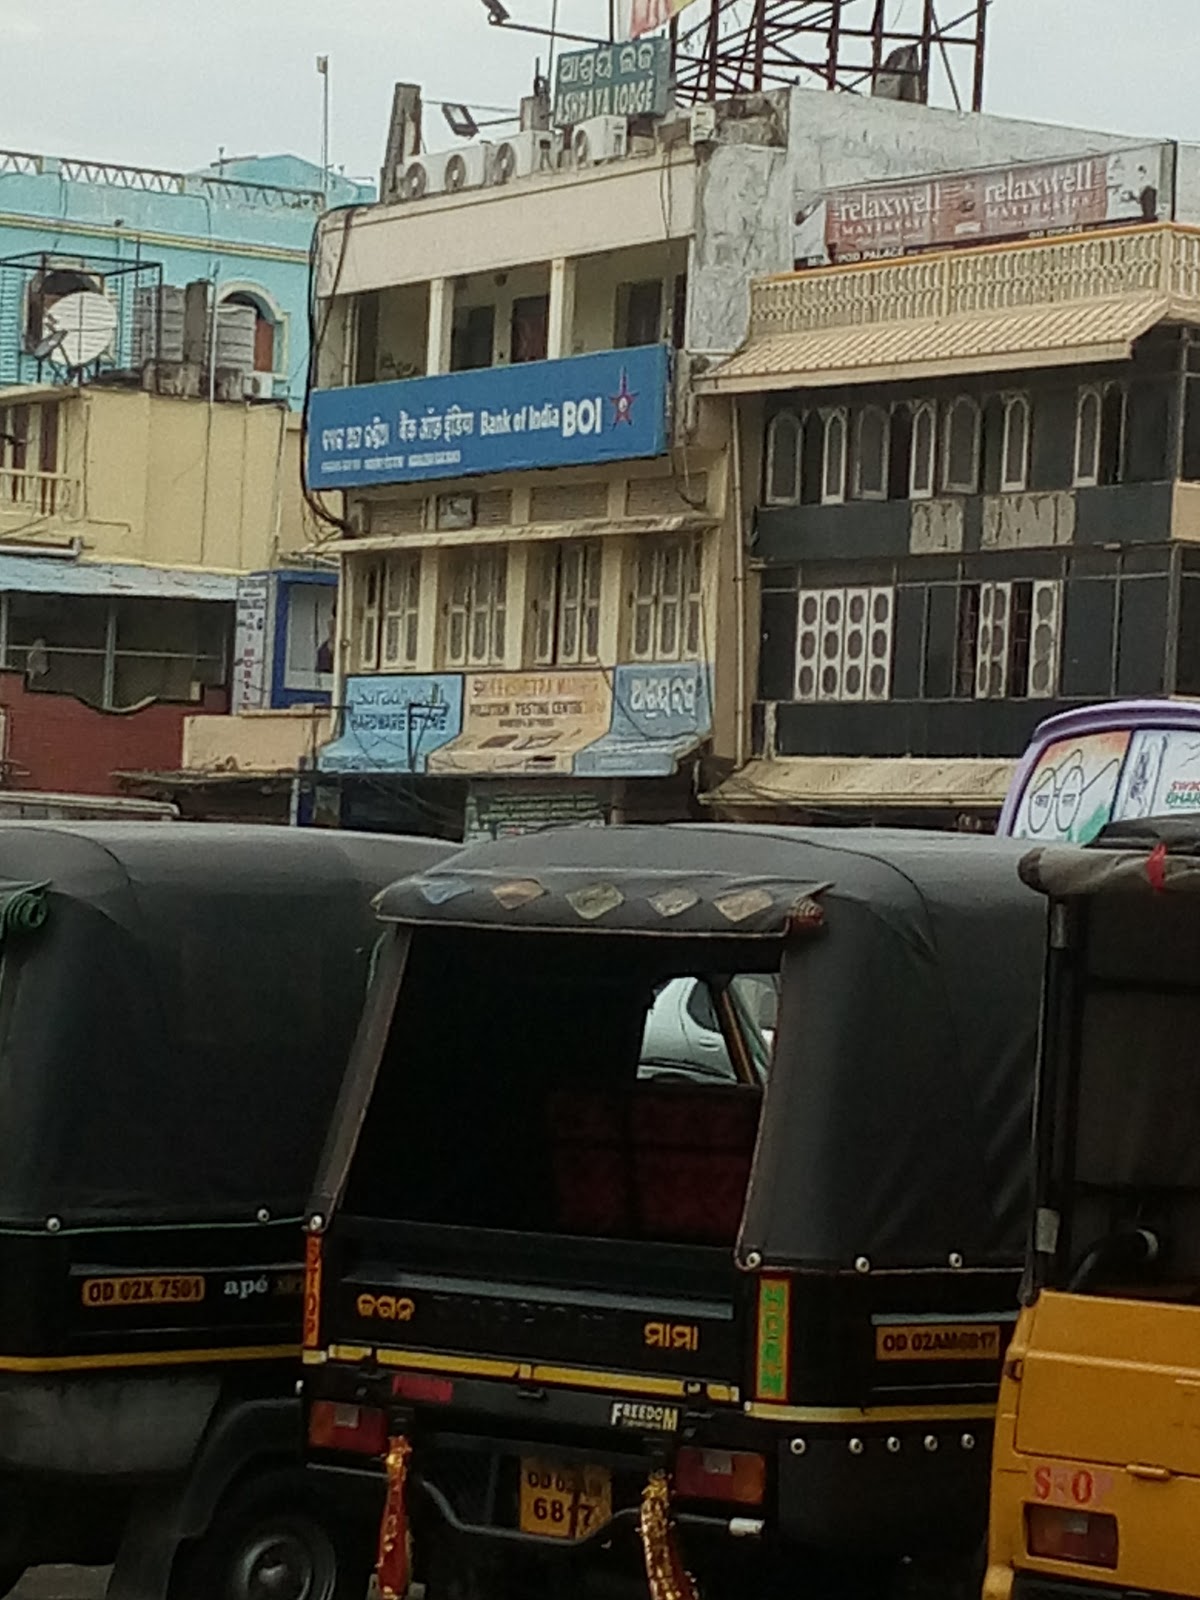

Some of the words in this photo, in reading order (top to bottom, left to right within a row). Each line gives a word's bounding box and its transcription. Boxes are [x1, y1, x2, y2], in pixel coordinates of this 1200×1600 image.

[984, 160, 1094, 204] relaxwell
[839, 183, 942, 222] relaxwell
[481, 408, 512, 436] Bank
[513, 406, 527, 432] of
[528, 403, 560, 430] India
[562, 397, 602, 438] BOI
[89, 1282, 115, 1303] OD
[223, 1275, 269, 1299] apé
[883, 1333, 908, 1352] OD
[610, 1403, 678, 1431] FREEDOM
